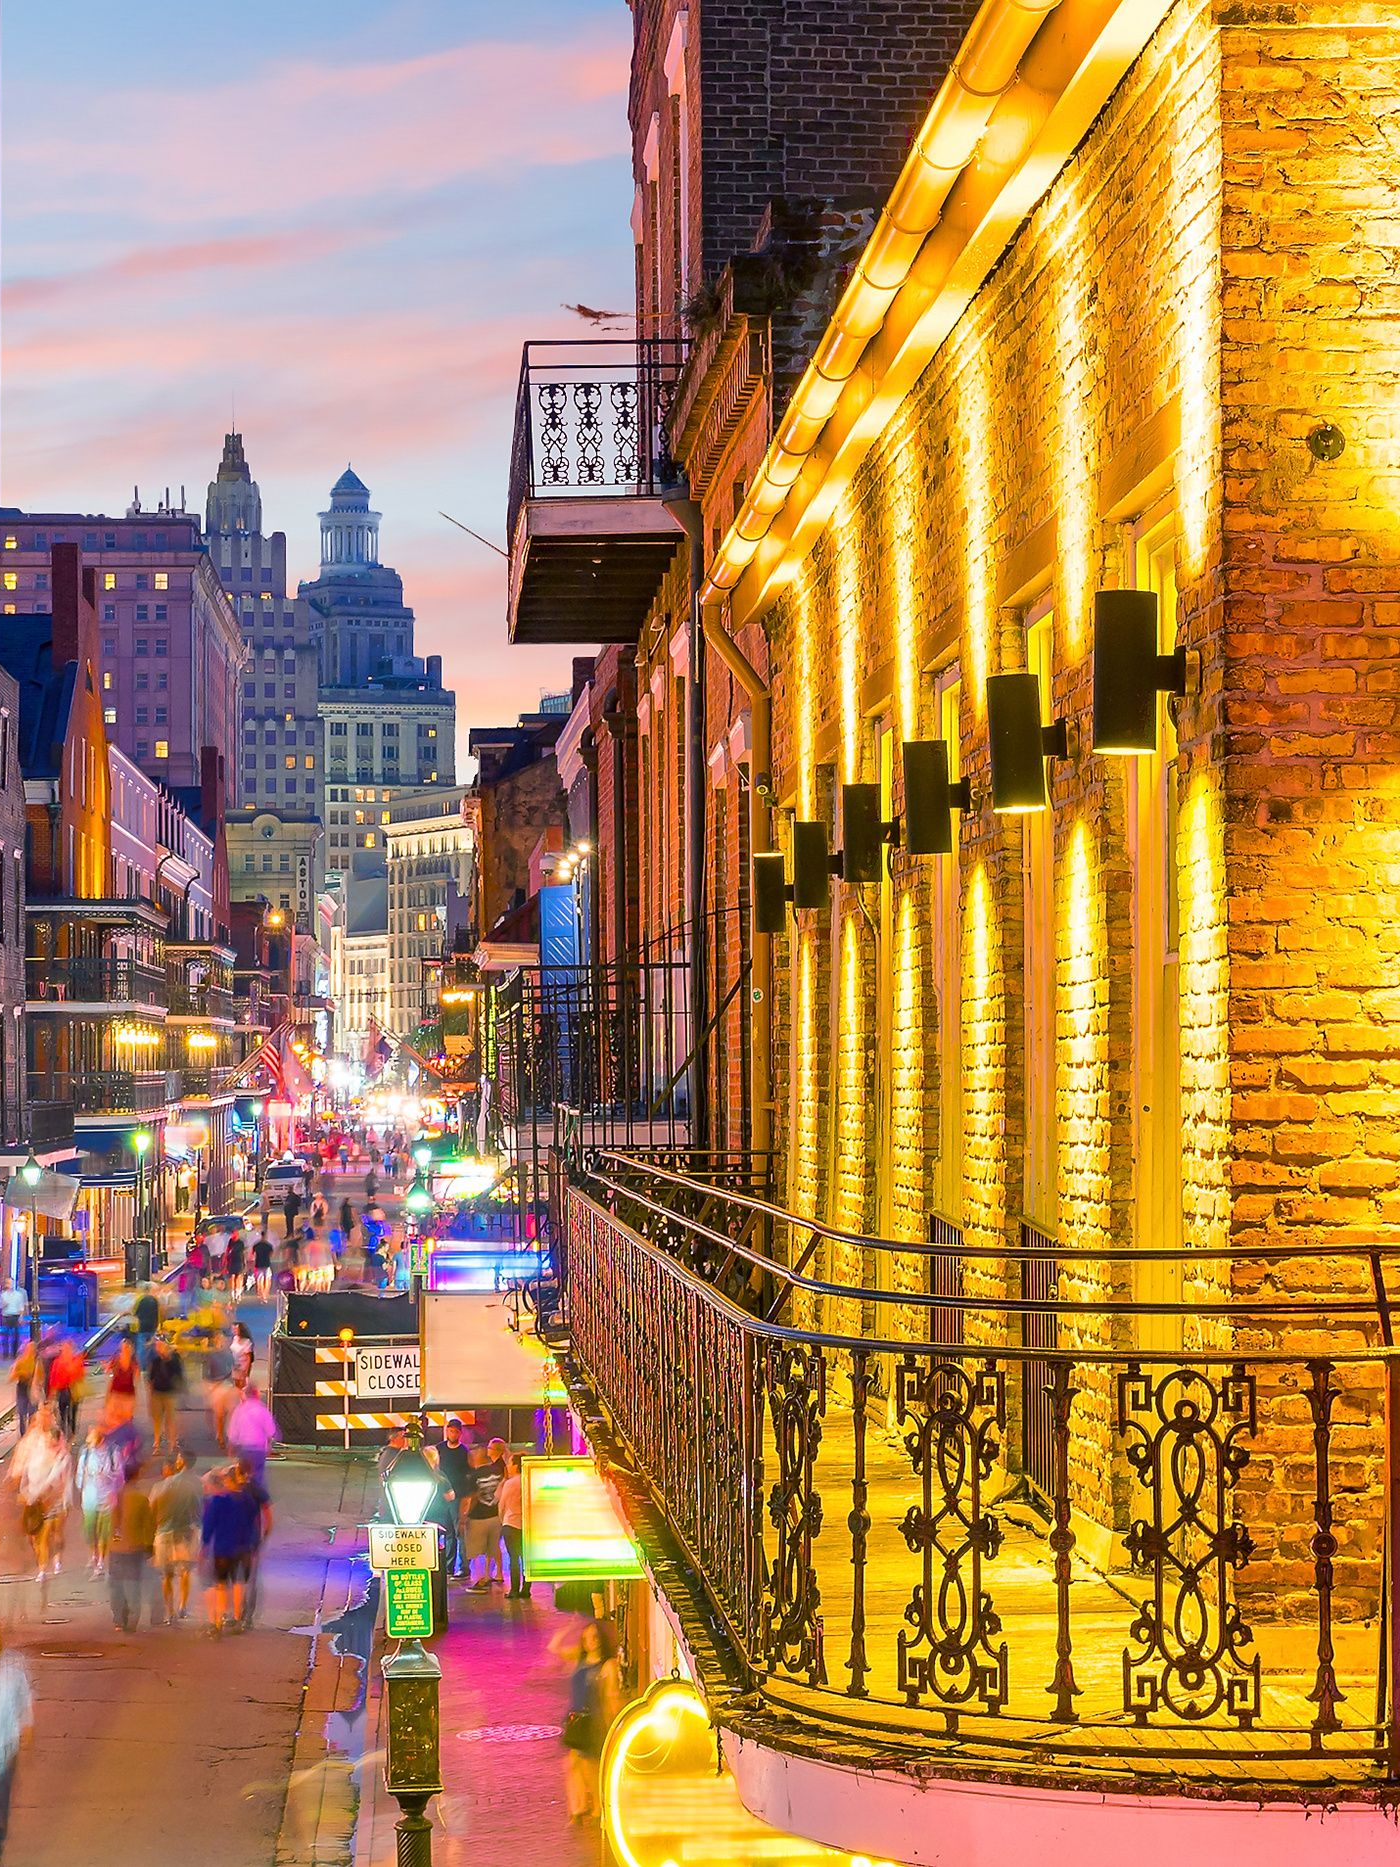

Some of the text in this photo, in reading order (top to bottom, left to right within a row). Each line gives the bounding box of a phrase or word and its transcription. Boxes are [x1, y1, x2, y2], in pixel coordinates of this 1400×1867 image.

[299, 856, 307, 911] ASTOR
[360, 1354, 420, 1370] SIDEWAL
[378, 1530, 427, 1539] SIDEWALK
[384, 1543, 423, 1553] CLOSED
[391, 1557, 416, 1566] HERE
